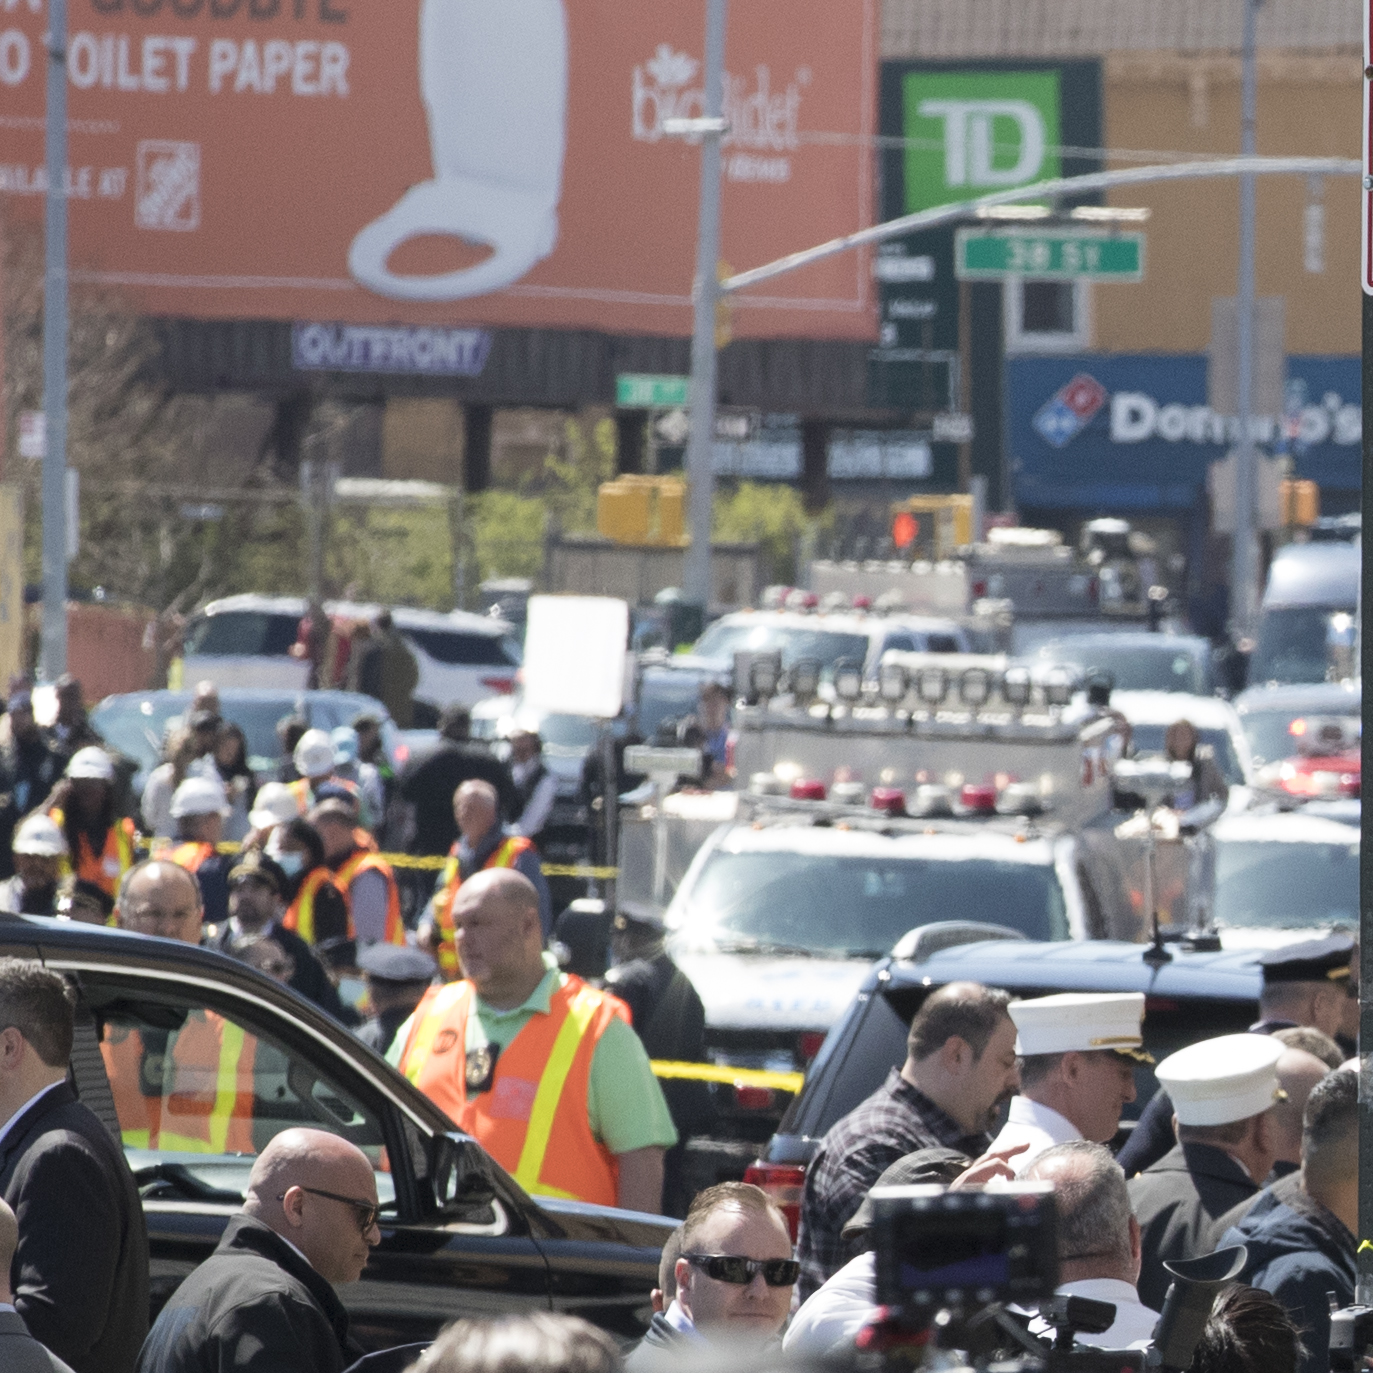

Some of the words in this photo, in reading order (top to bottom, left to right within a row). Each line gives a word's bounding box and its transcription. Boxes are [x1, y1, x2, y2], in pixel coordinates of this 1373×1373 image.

[40, 30, 196, 92] OILET
[208, 38, 350, 97] PAPER
[916, 100, 1046, 188] TD
[300, 323, 478, 371] OUTFRONT
